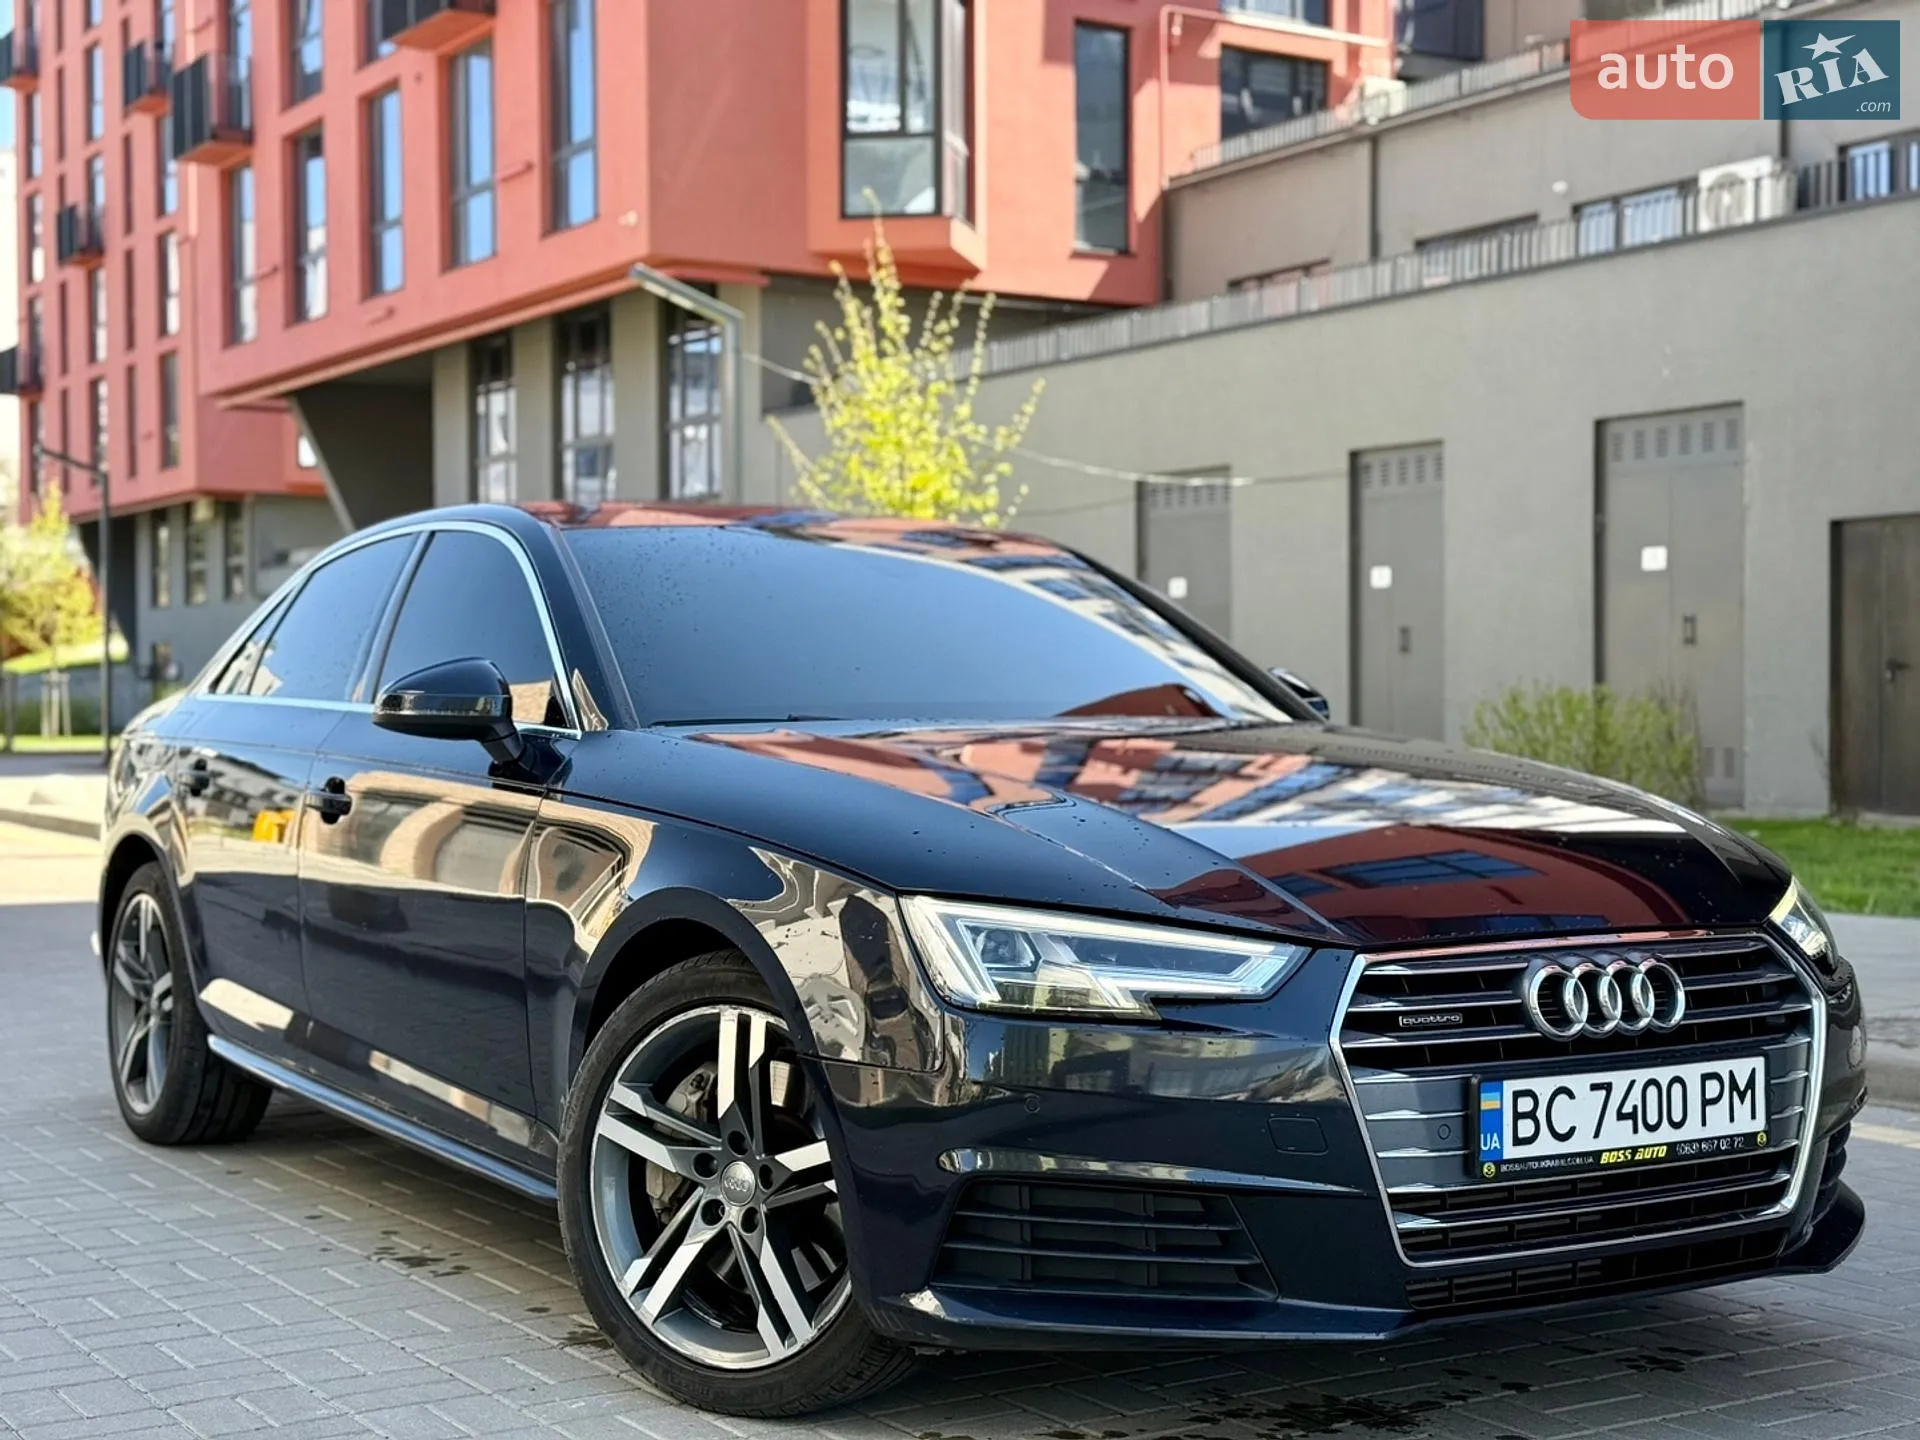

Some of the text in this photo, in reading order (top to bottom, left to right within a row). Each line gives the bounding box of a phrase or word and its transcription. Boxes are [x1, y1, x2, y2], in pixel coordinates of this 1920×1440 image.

[1402, 1014, 1460, 1026] quattro
[1512, 1067, 1757, 1147] BC 7400 PM
[1480, 1132, 1500, 1151] UA
[1600, 1149, 1632, 1165] BOSS
